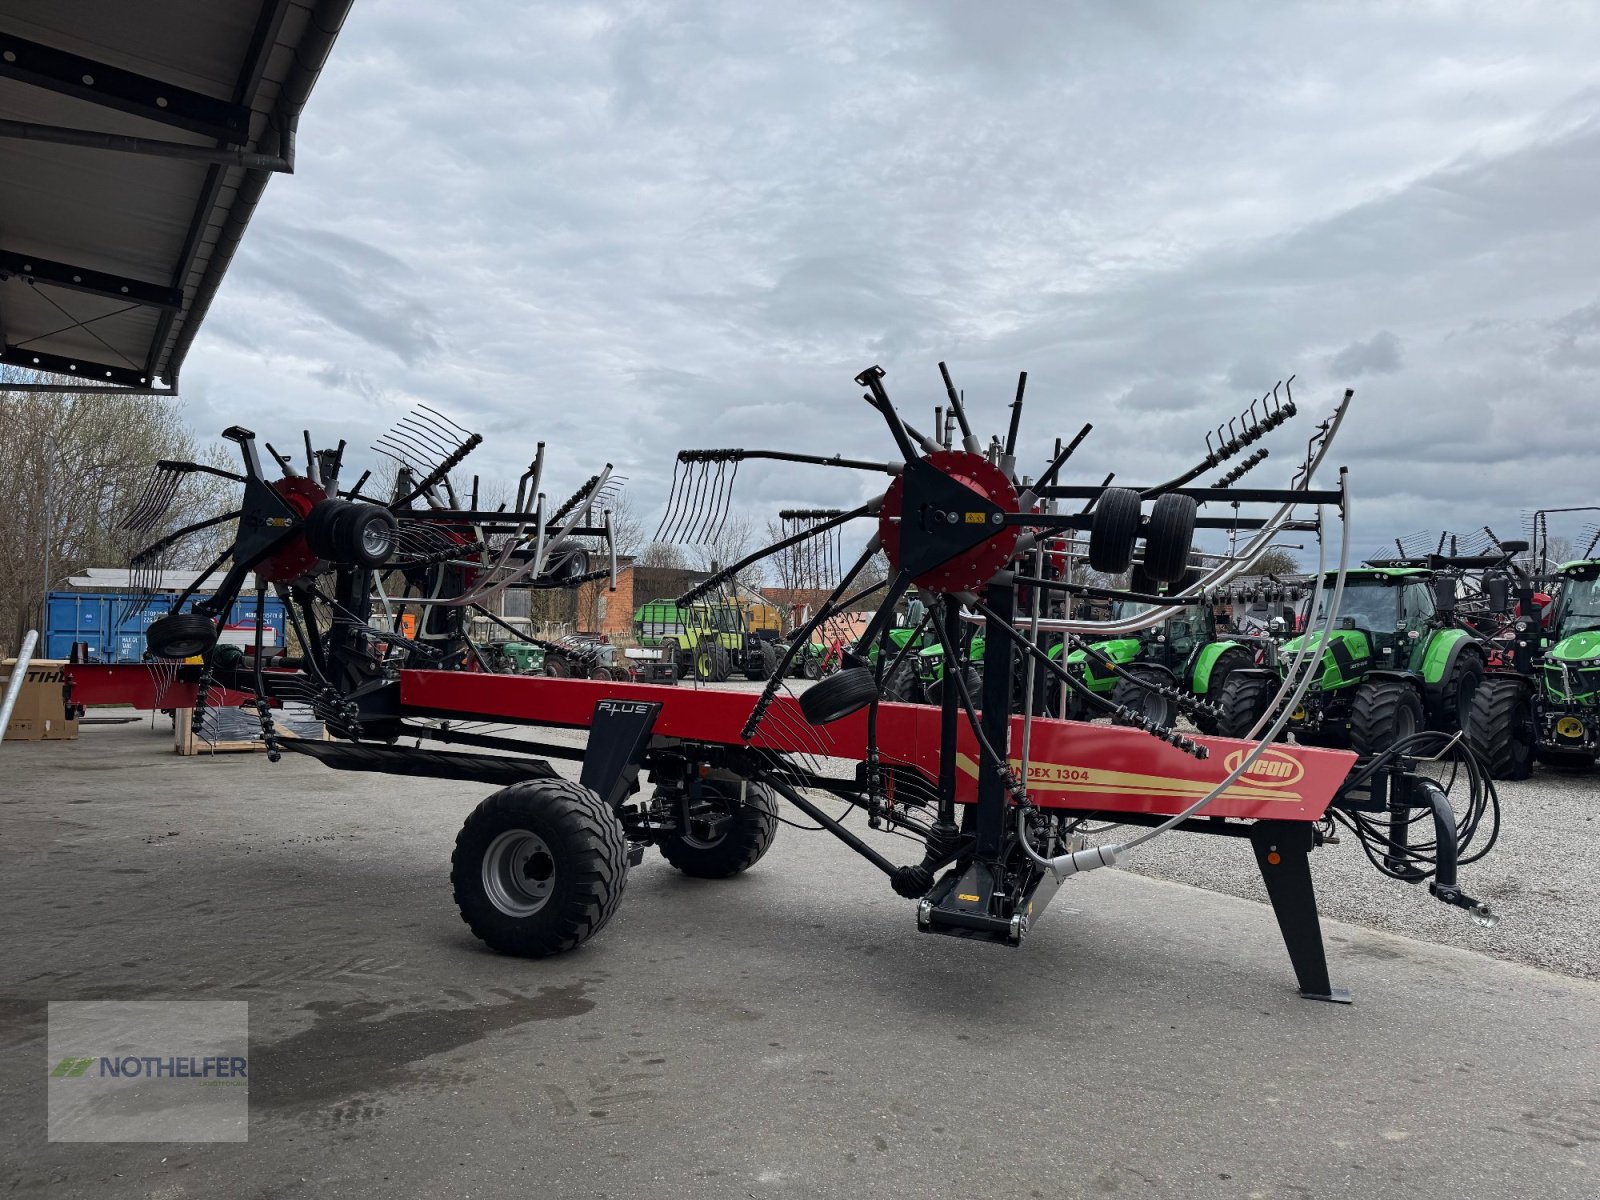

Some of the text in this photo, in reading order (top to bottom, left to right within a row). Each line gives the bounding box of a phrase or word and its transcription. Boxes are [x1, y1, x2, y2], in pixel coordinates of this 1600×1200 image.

[23, 671, 65, 683] TIHL
[598, 702, 648, 717] PLUS
[1056, 769, 1089, 781] 1304
